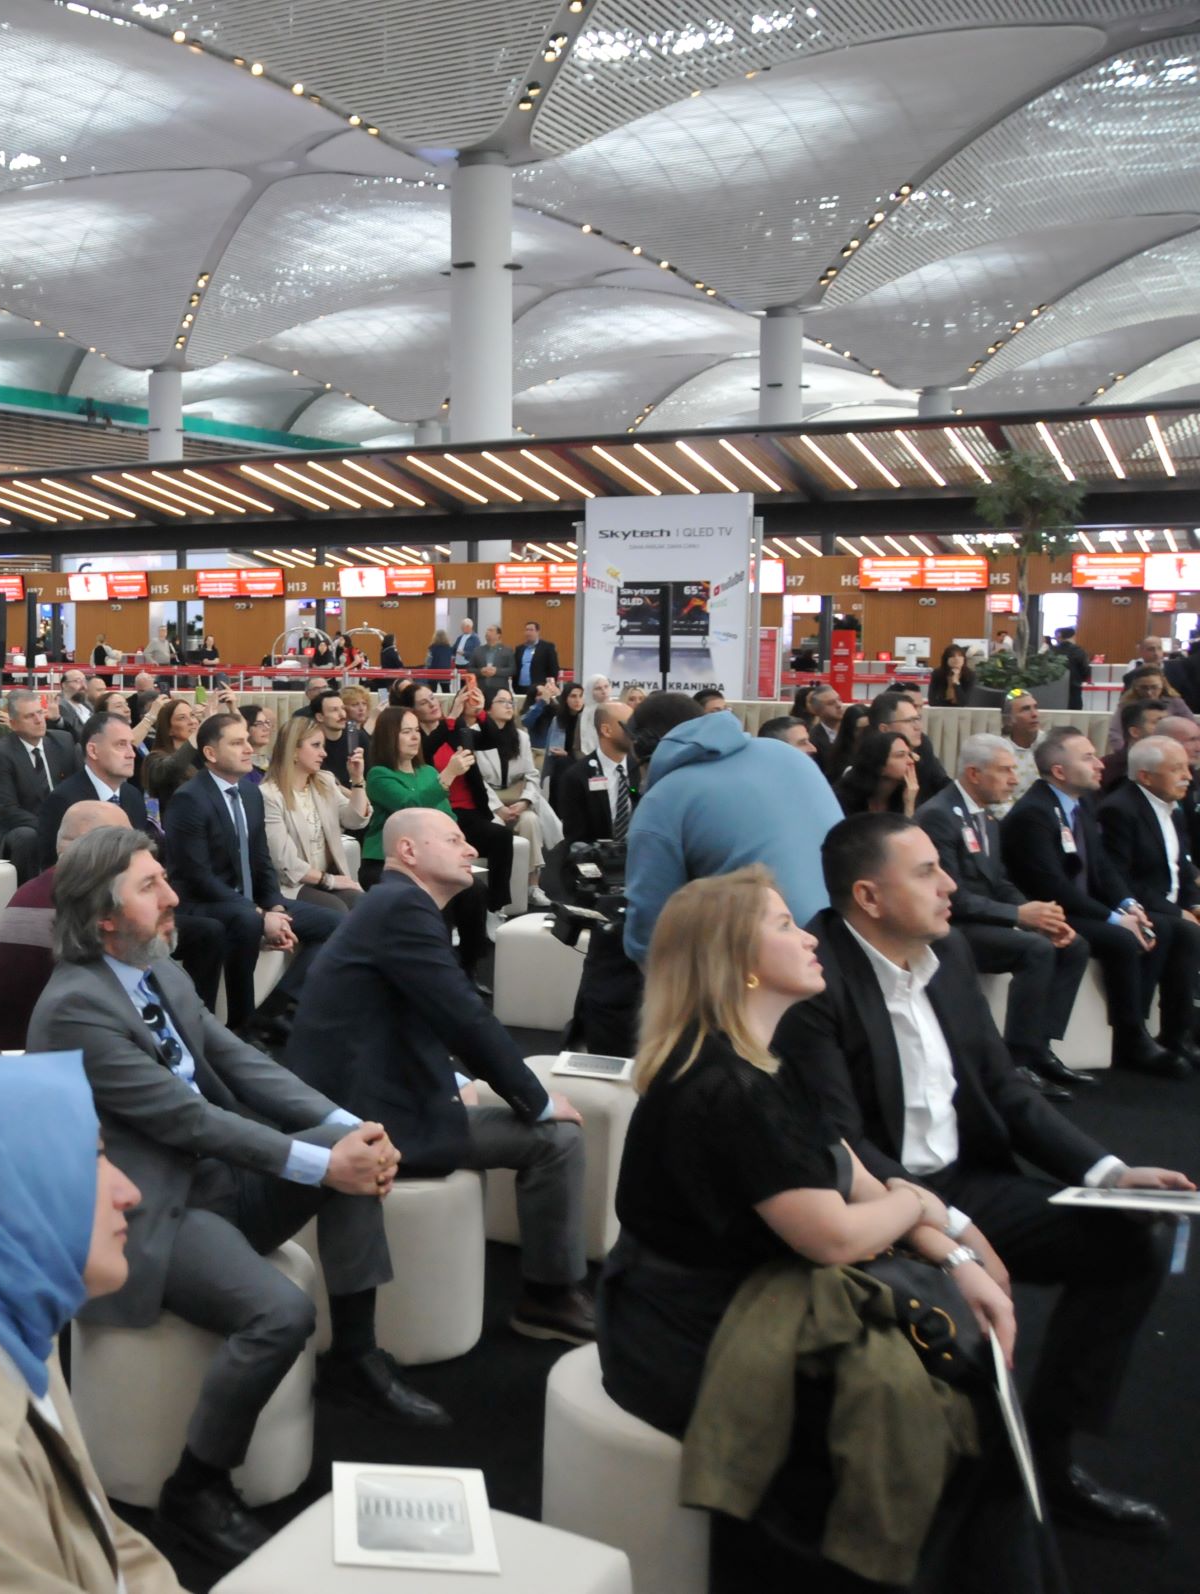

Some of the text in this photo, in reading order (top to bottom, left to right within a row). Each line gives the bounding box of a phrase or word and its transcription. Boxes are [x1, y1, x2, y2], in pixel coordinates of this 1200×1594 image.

[598, 526, 733, 541] Skytech QLED TV
[786, 575, 805, 586] H7
[841, 575, 860, 586] H6
[989, 573, 1010, 584] H5
[151, 584, 169, 594] H15
[287, 581, 307, 592] H13
[437, 580, 456, 590] H11
[585, 576, 614, 594] NETFLIX
[620, 597, 644, 606] QLED
